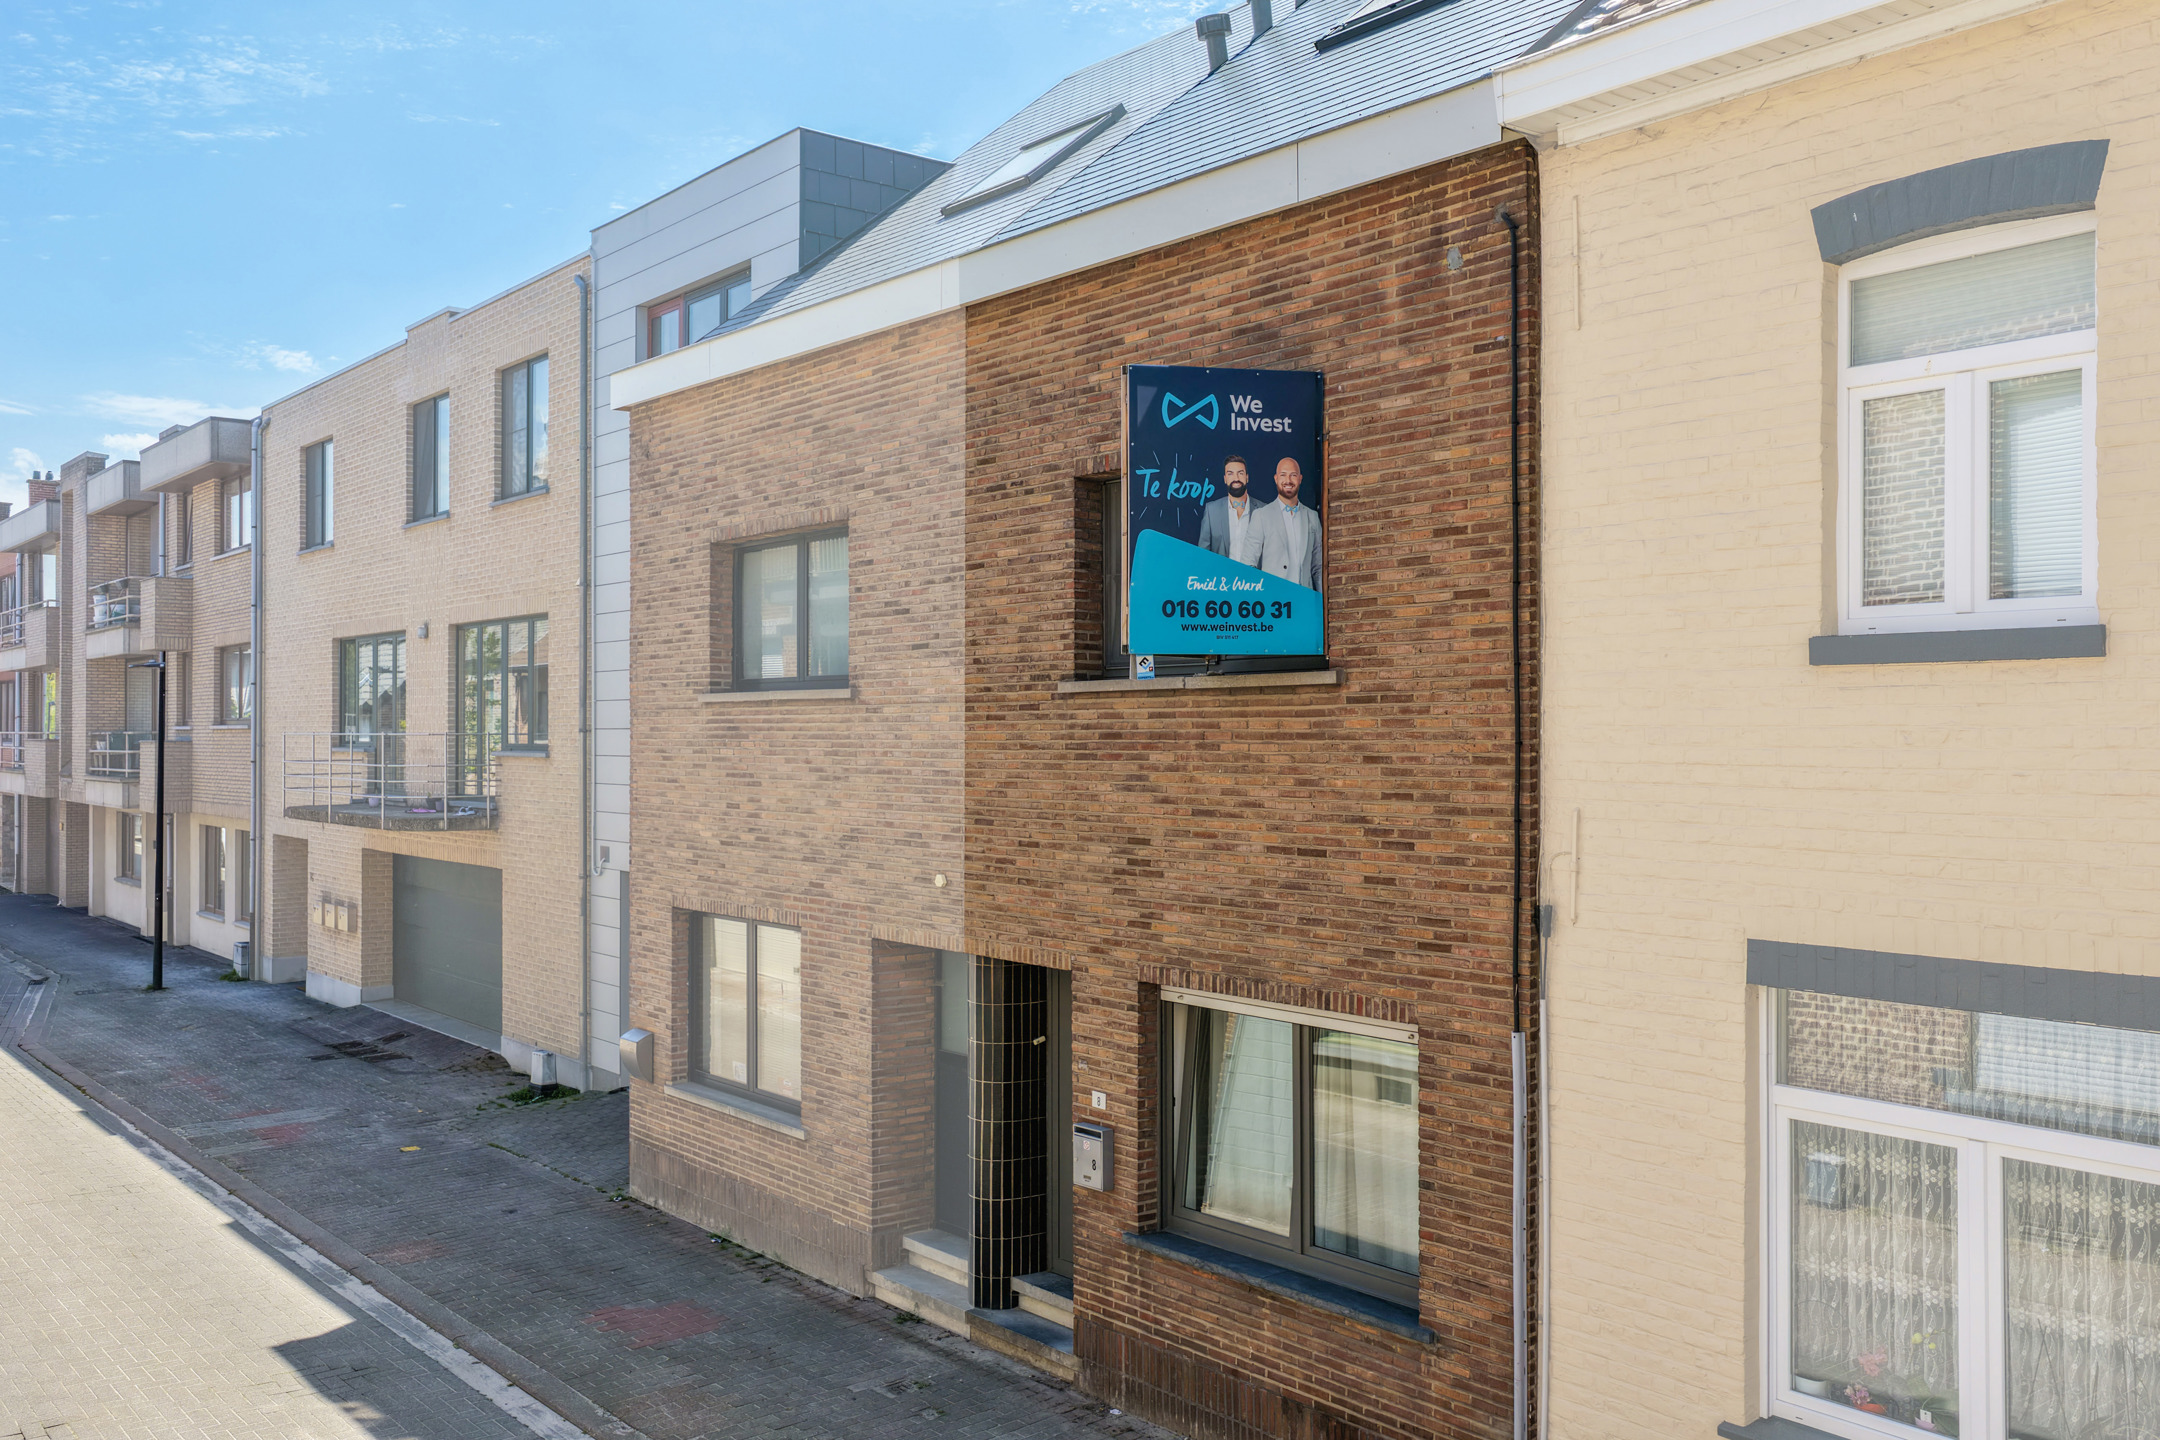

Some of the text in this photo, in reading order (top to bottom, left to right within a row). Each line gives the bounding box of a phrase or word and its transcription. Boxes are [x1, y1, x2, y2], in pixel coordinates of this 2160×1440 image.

[1229, 394, 1263, 413] We
[1231, 413, 1292, 433] Invest
[1135, 468, 1215, 506] Te koop
[1219, 577, 1231, 592] &
[1232, 578, 1264, 592] Ward
[1161, 599, 1292, 619] 016 60 60 31
[1181, 622, 1274, 632] www.weinvest.be
[1097, 1096, 1101, 1106] 8
[1092, 1159, 1096, 1171] 8
